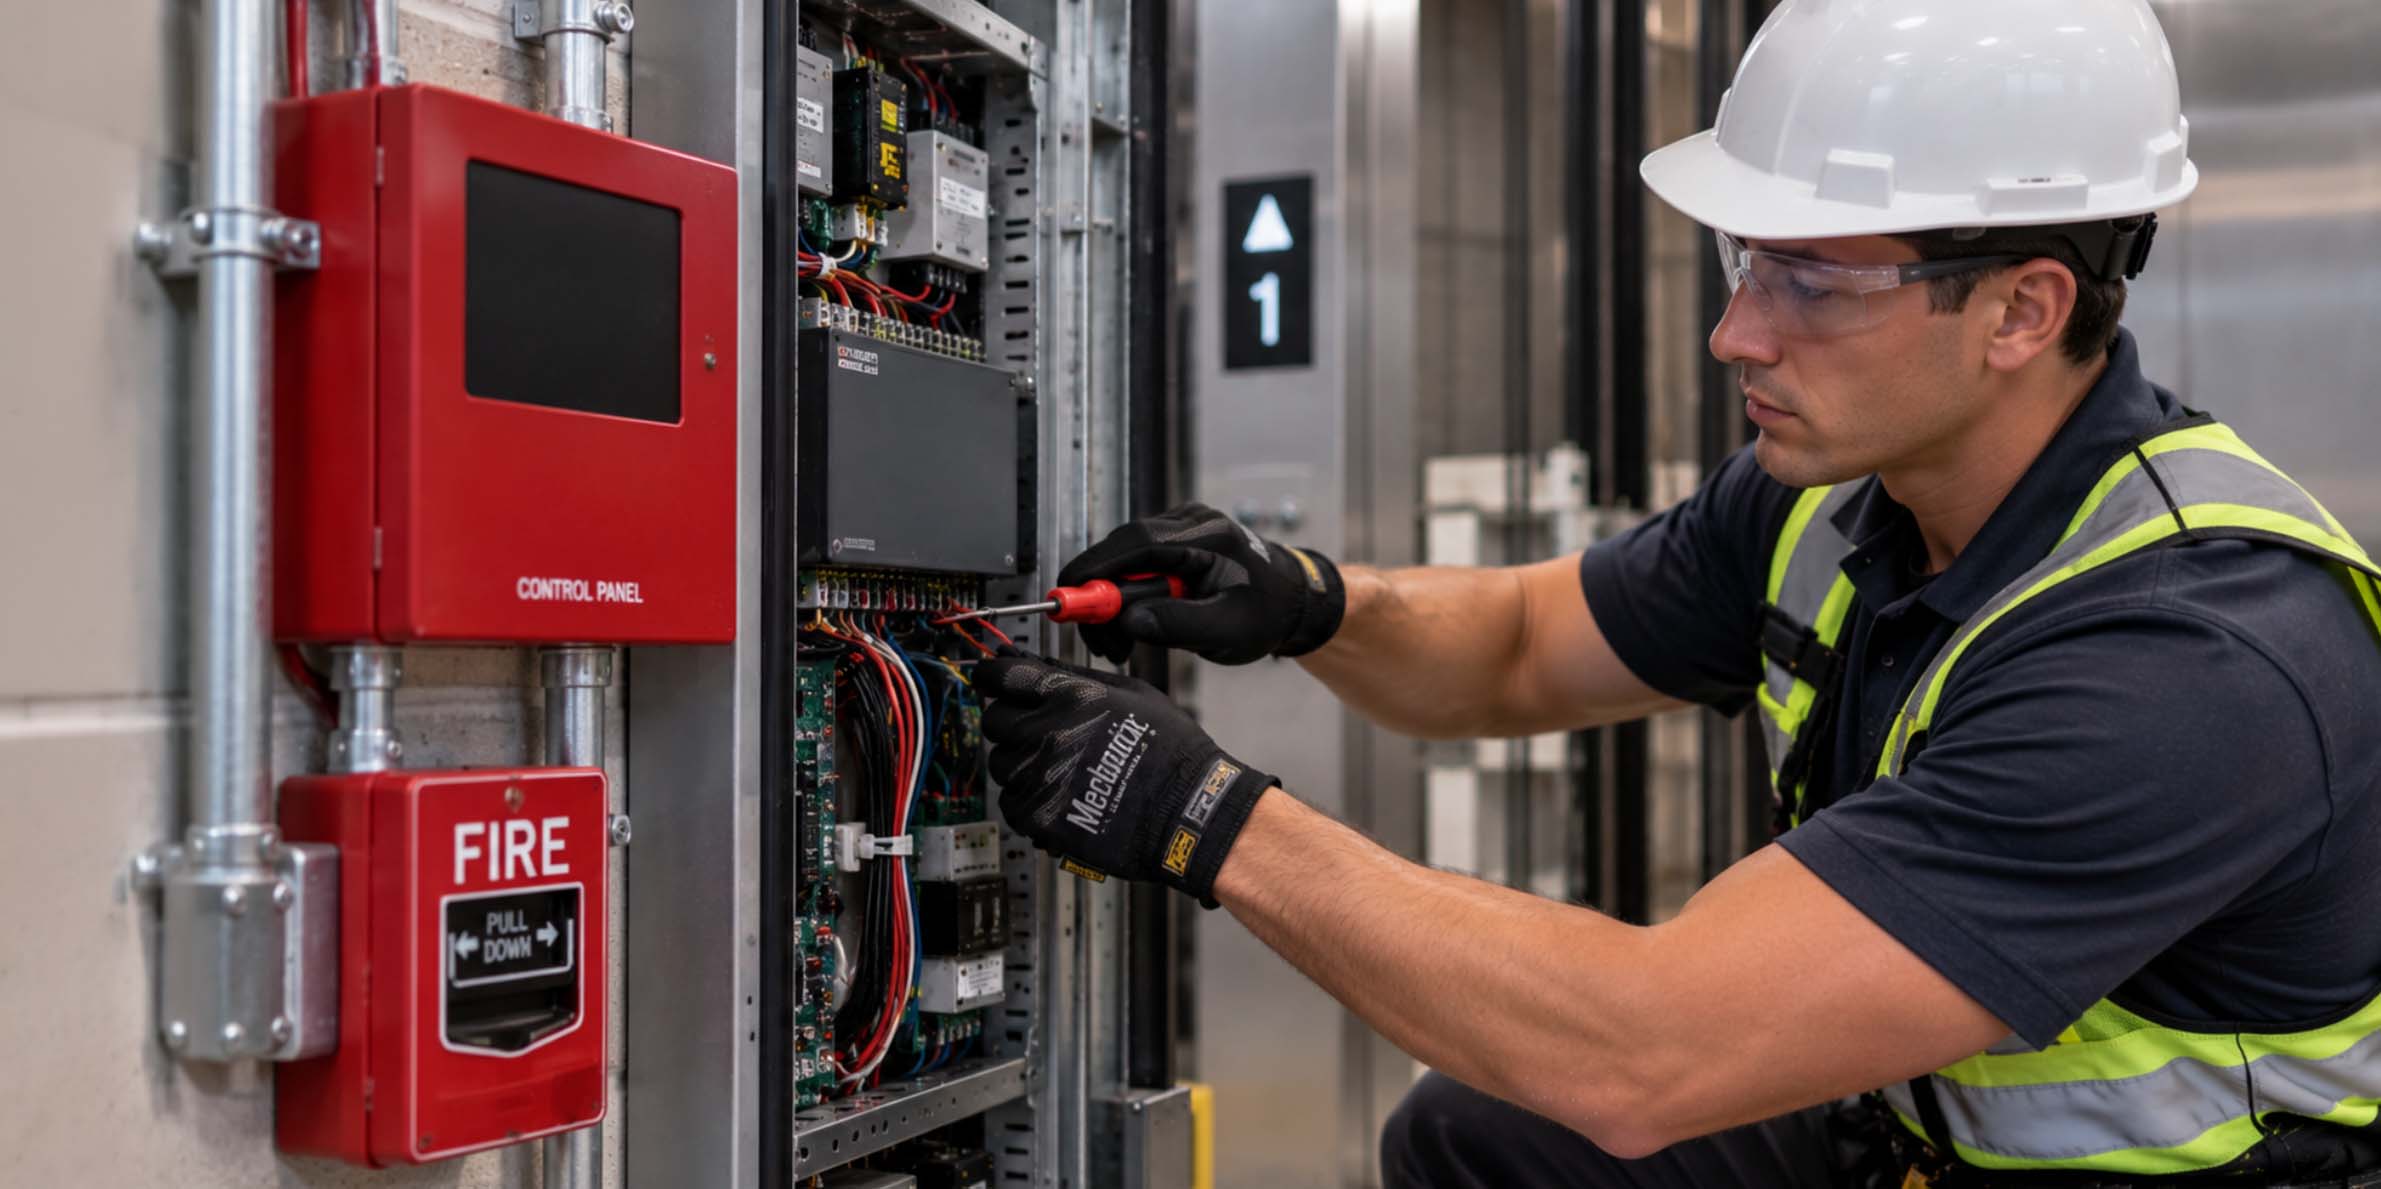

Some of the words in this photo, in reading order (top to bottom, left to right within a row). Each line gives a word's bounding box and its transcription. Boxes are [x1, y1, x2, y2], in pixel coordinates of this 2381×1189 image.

[1249, 271, 1280, 347] 1
[517, 576, 593, 602] CONTROL
[596, 580, 643, 603] PANEL
[454, 816, 570, 885] FIRE
[486, 909, 529, 935] PULL
[483, 935, 532, 964] DOWN
